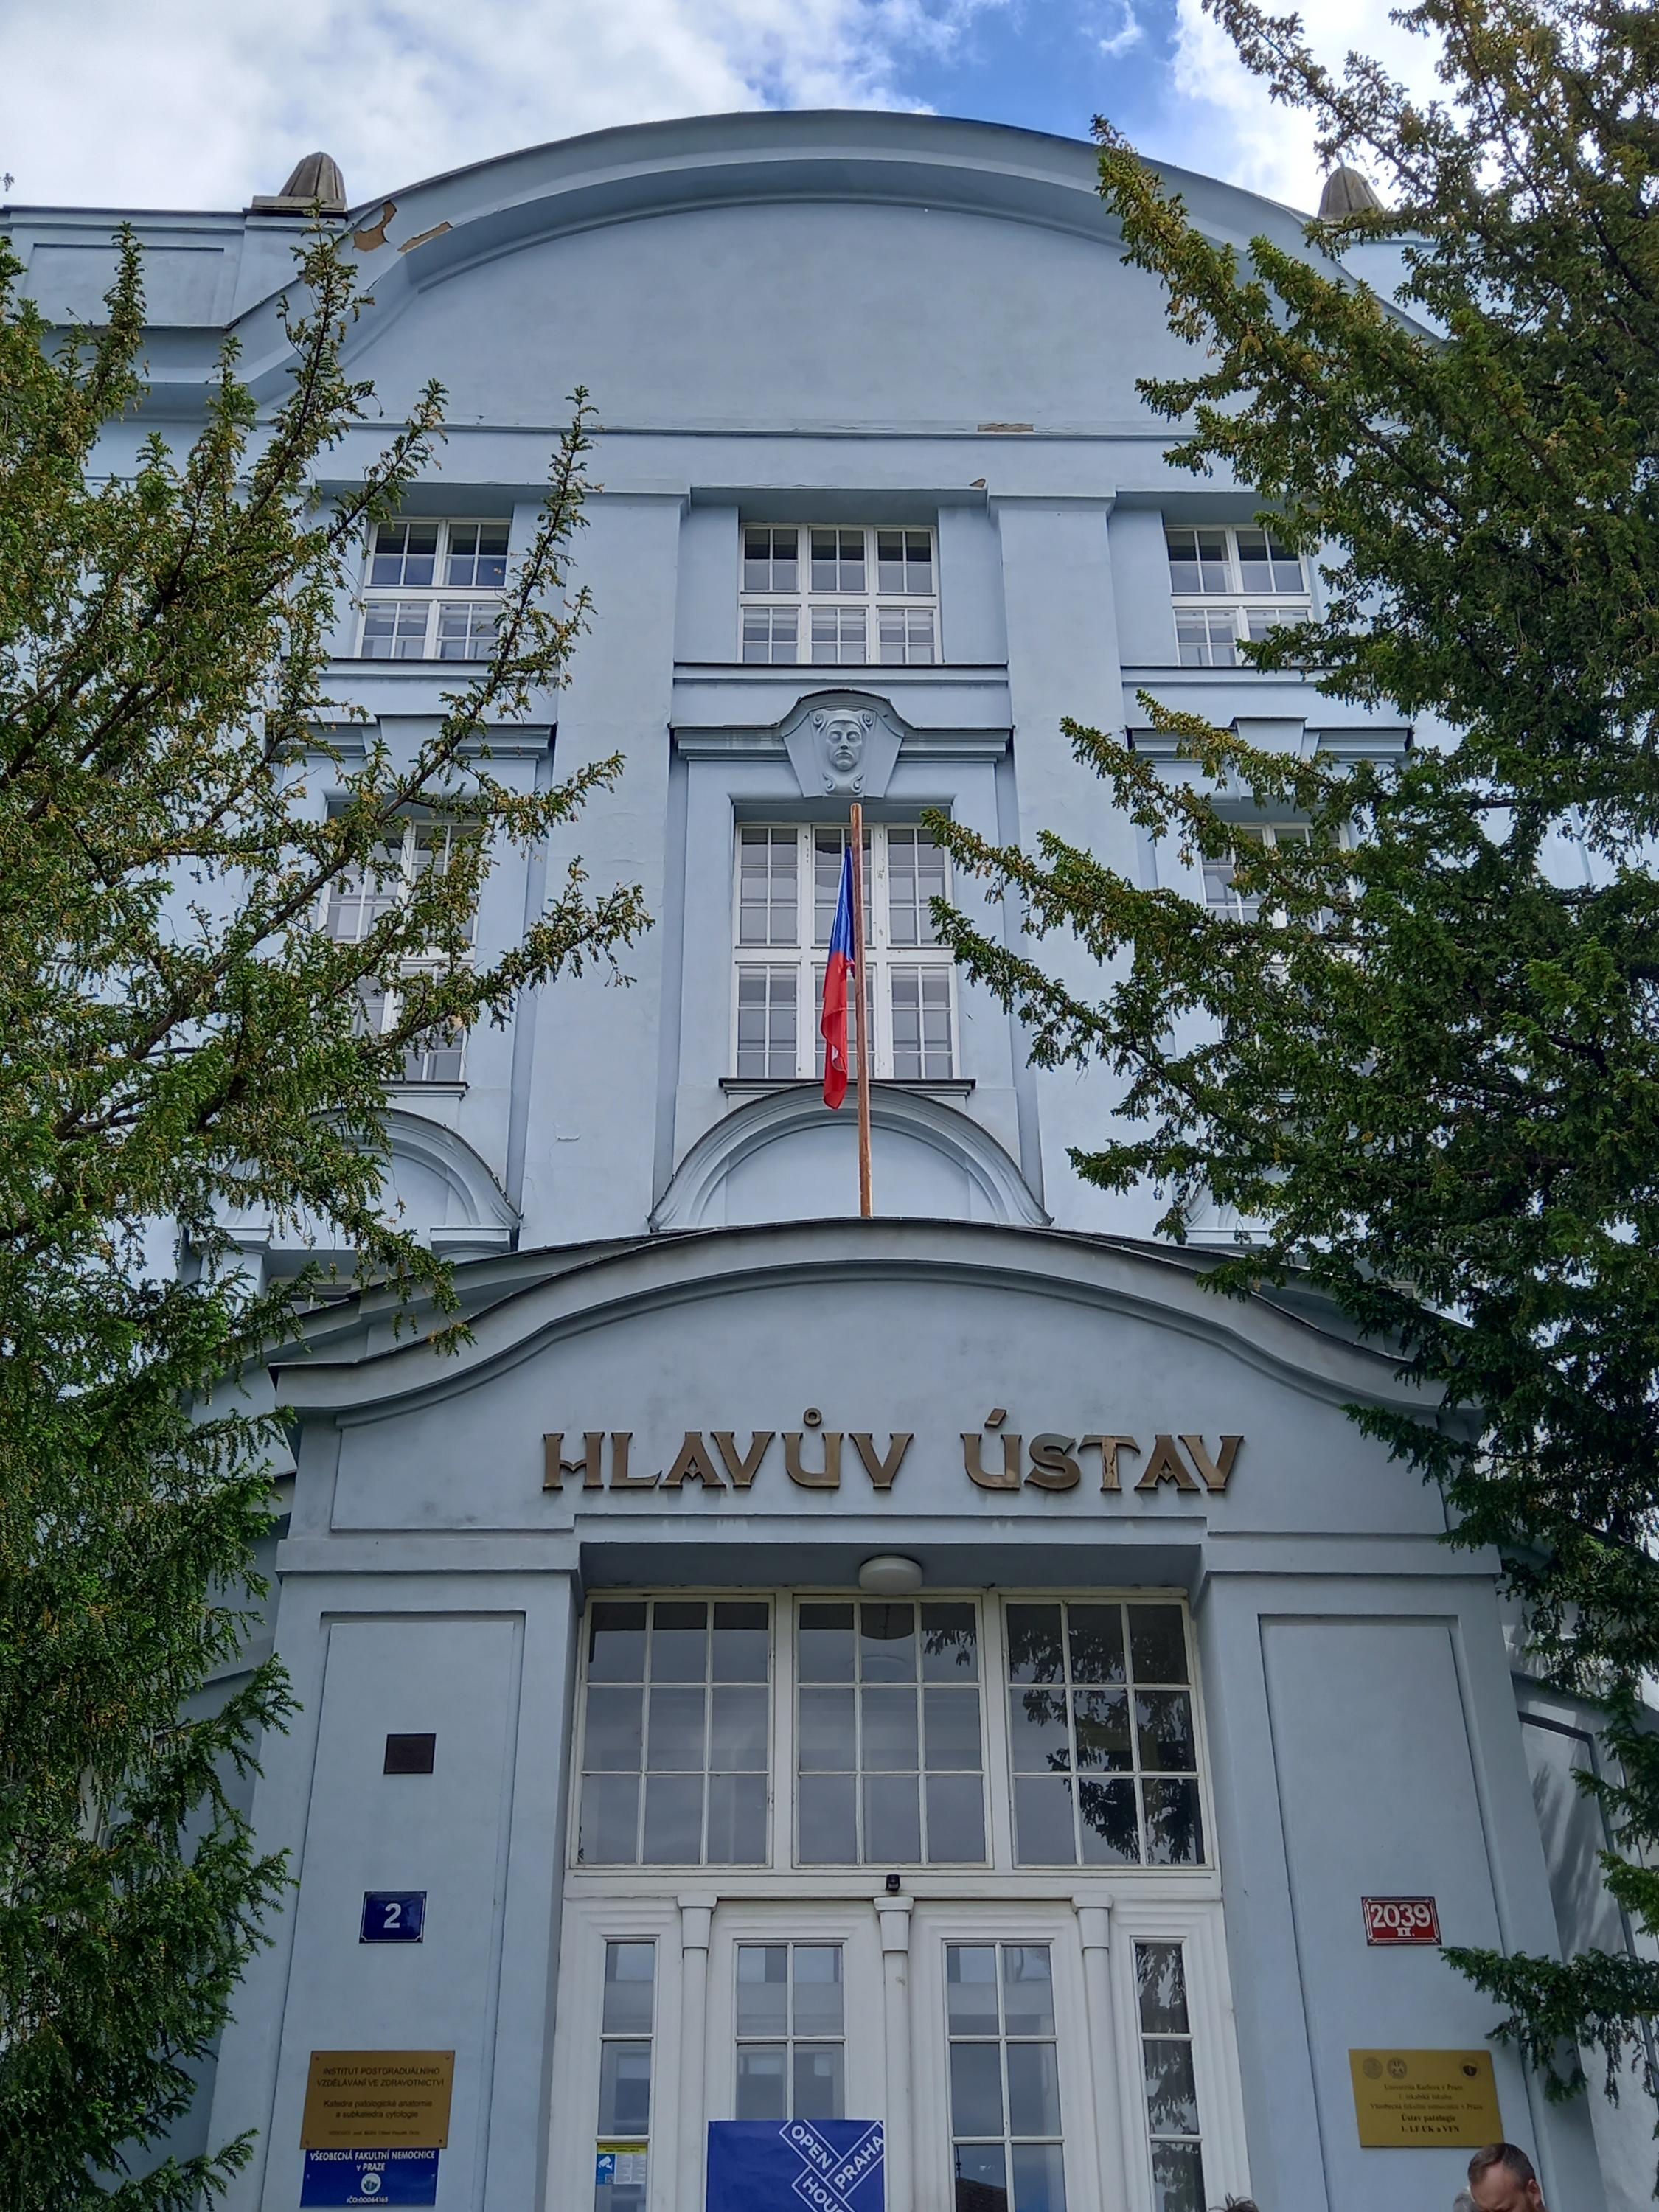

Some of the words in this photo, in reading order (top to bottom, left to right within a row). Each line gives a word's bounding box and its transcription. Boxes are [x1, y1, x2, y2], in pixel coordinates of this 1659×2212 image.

[541, 1407, 915, 1492] HLAVŮV
[960, 1408, 1245, 1493] ÚSTAV
[383, 1902, 402, 1929] 2
[1370, 1903, 1431, 1928] 2039
[323, 2067, 359, 2076] INSTITUT
[368, 2079, 379, 2087] VE
[380, 2078, 445, 2087] ZDRAVOTNICTVÍ
[323, 2099, 352, 2108] Katedra
[342, 2110, 383, 2118] subkatedra
[385, 2110, 419, 2119] cytologie
[310, 2149, 353, 2161] VŠEOBECNÁ
[355, 2149, 391, 2160] FAKULTNÍ
[392, 2150, 436, 2160] NEMOCNICE
[790, 2125, 832, 2170] OPEN
[362, 2163, 386, 2171] PRAZE
[833, 2135, 884, 2190] PRAHA
[801, 2176, 844, 2212] HOU
